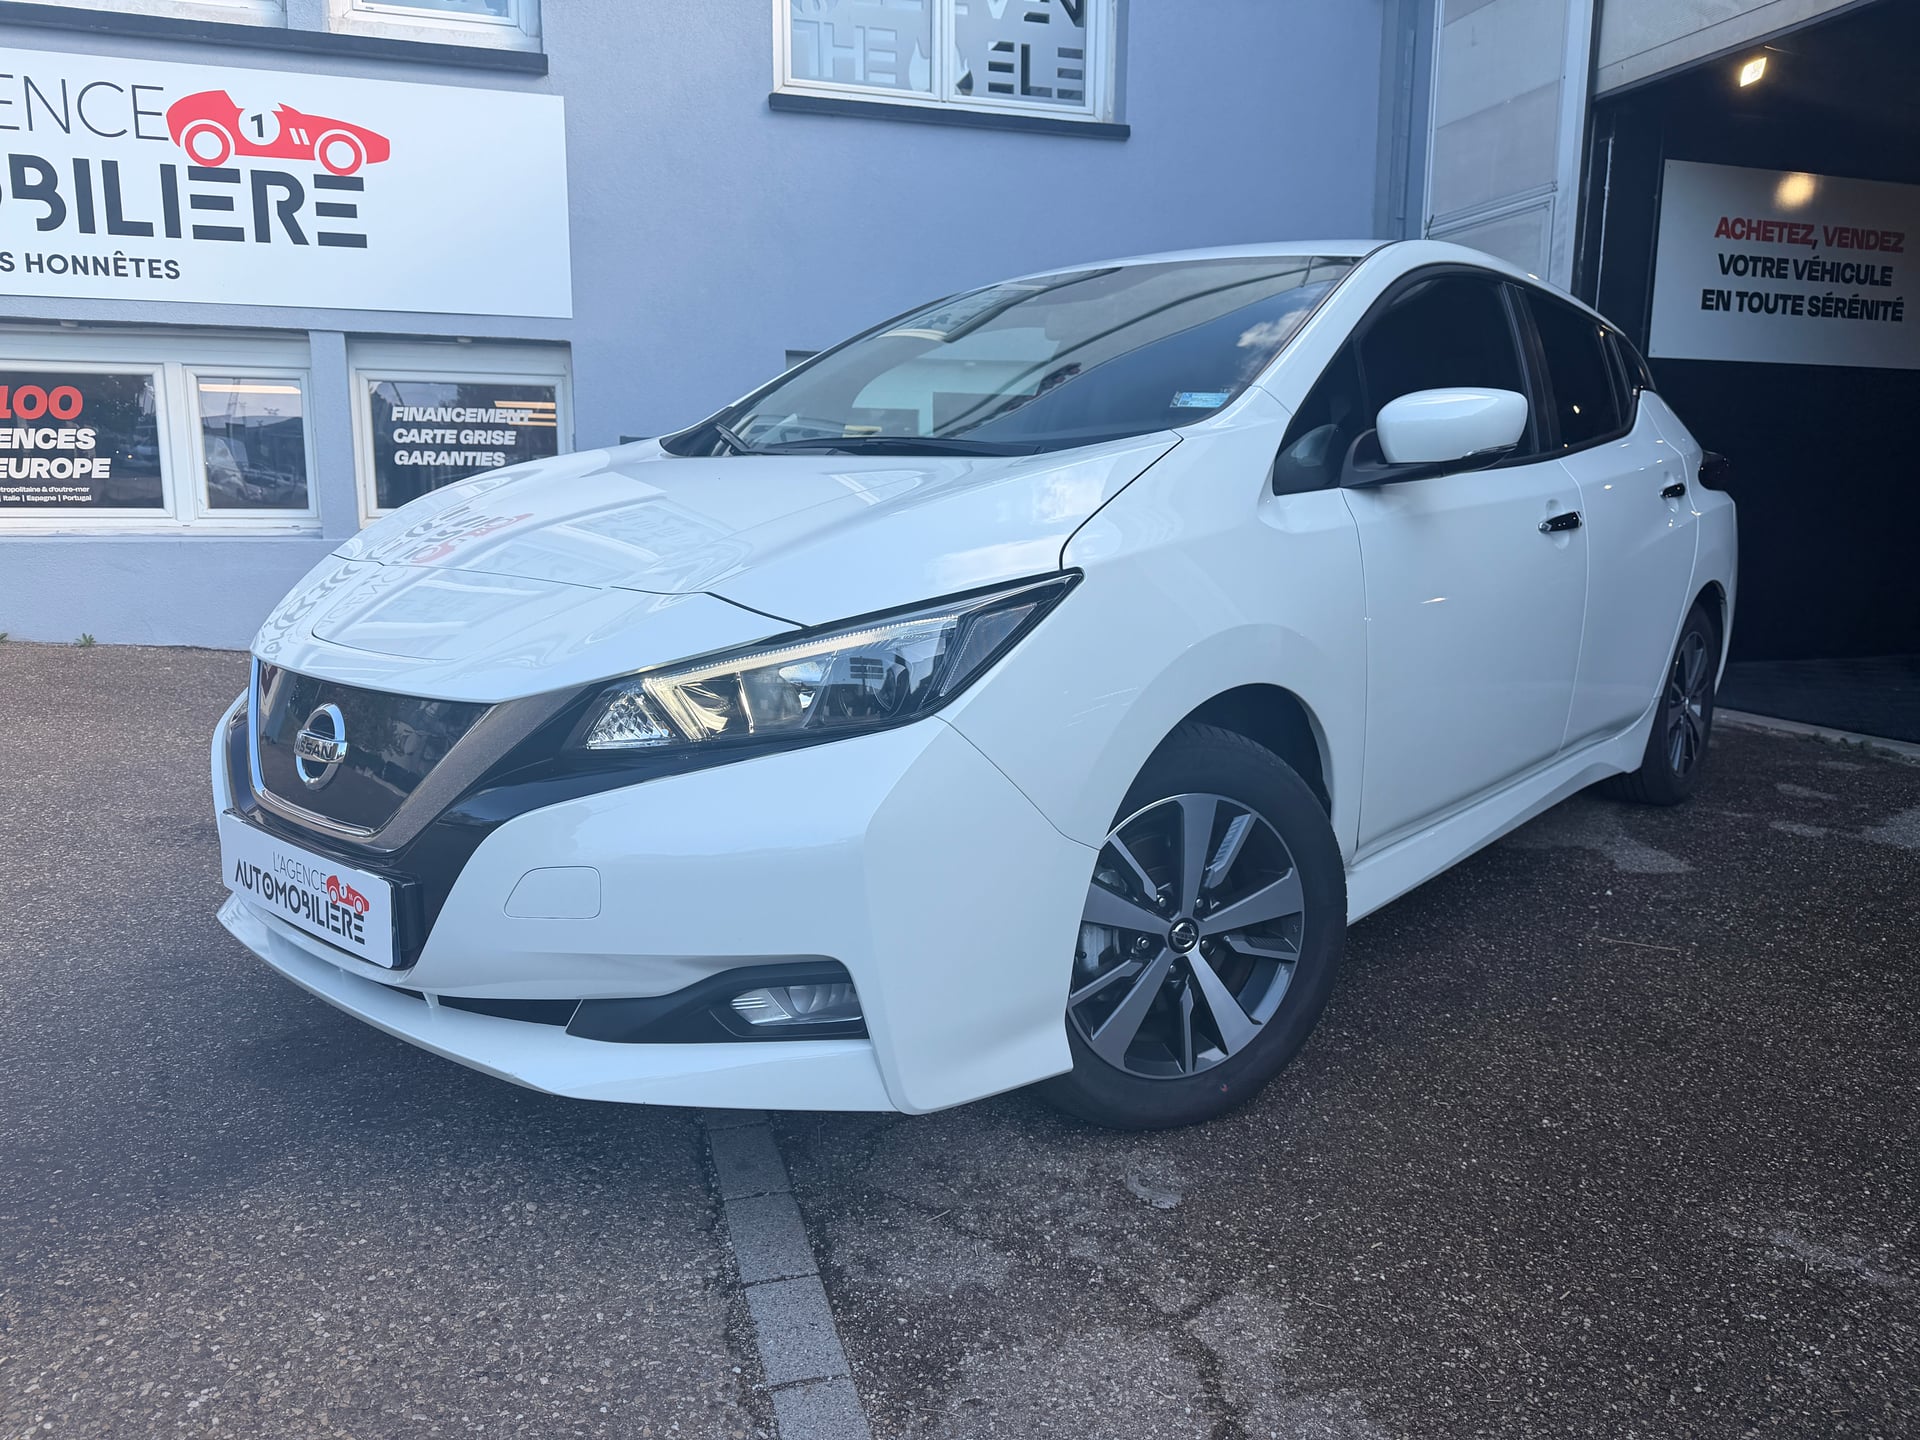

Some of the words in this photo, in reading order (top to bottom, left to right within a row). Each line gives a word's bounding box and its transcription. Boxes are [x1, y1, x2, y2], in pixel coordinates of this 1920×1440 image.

[0, 153, 368, 249] BILIERE
[1714, 216, 1818, 250] ACHETEZ,
[1823, 225, 1905, 253] VENDEZ
[25, 250, 180, 280] HONNÊTES
[1718, 253, 1789, 279] VOTRE
[1793, 255, 1893, 287] VÉHICULE
[1701, 288, 1731, 311] EN
[1735, 290, 1804, 316] TOUTE
[1807, 291, 1904, 322] SÉRÉNITÉ
[391, 406, 533, 424] FINANCEMENT
[393, 428, 457, 445] CARTE
[459, 430, 517, 446] GRISE
[394, 450, 506, 467] GARANTIES
[272, 851, 328, 895] L'AGENCE
[235, 858, 366, 946] AUTOMOBILIERE
